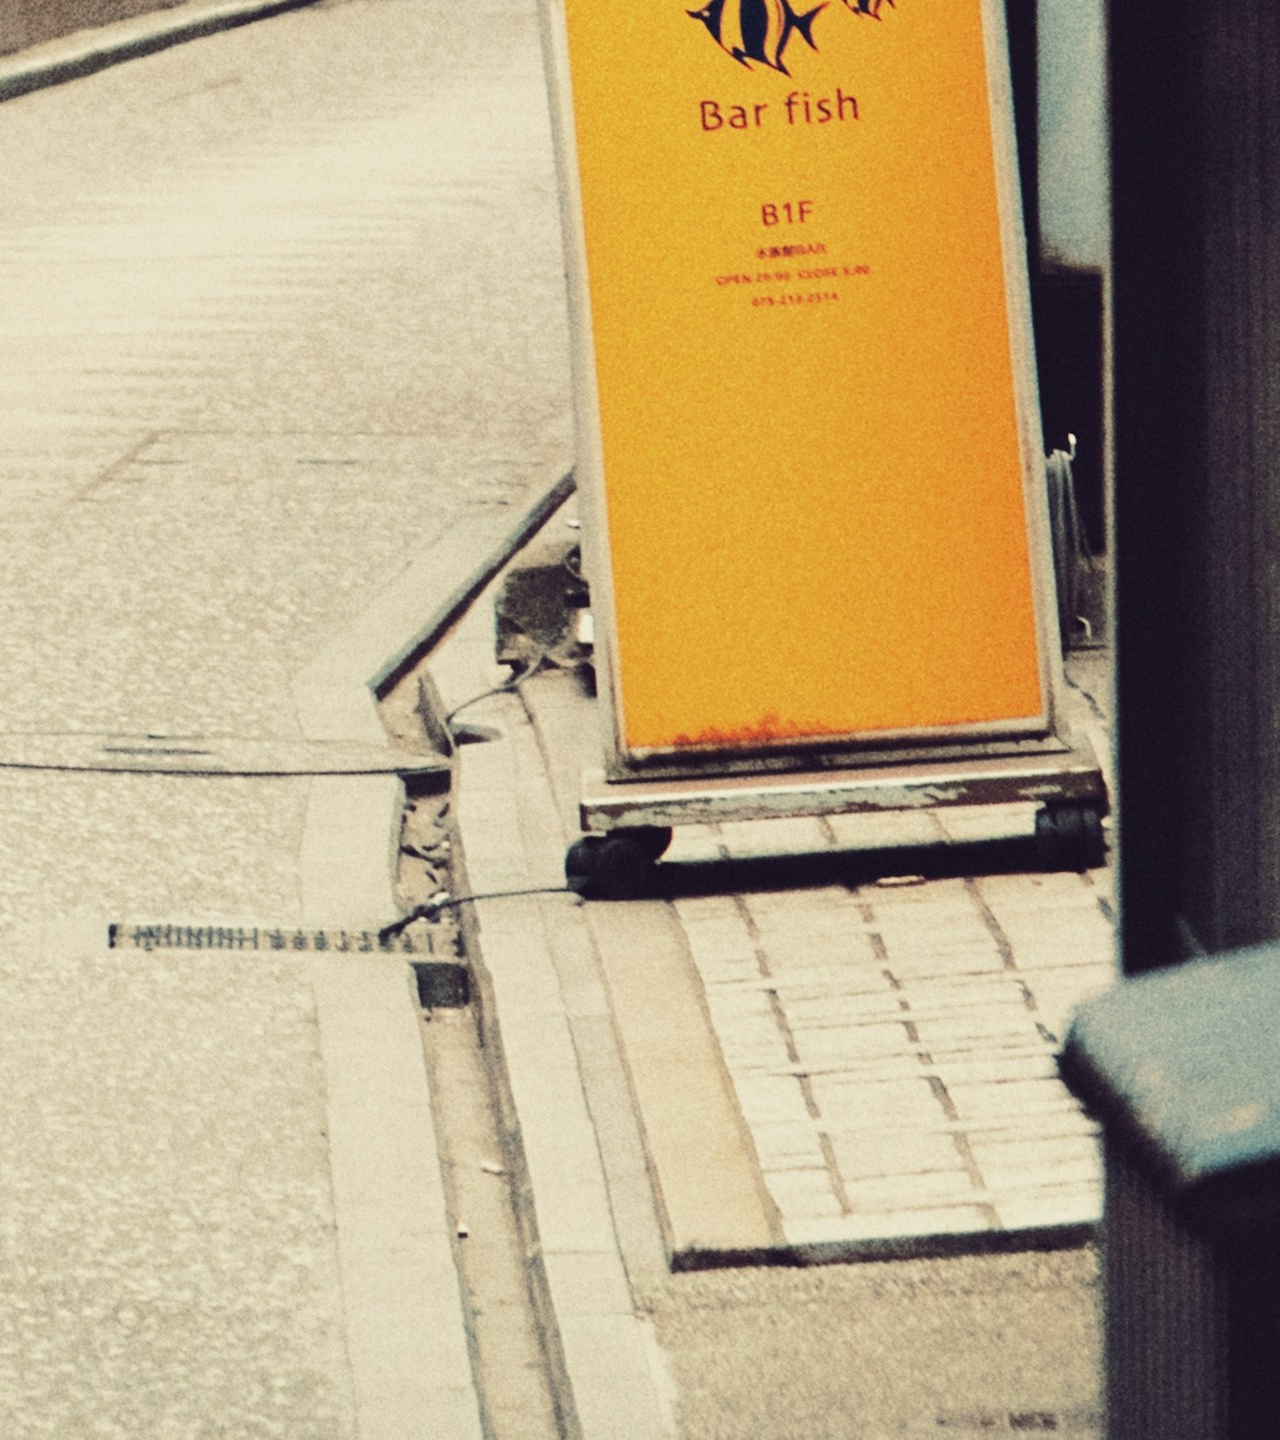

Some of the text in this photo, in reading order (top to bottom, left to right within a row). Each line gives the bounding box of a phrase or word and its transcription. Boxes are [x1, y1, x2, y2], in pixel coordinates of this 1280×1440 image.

[700, 87, 859, 132] Bar fish
[761, 200, 815, 227] B1F
